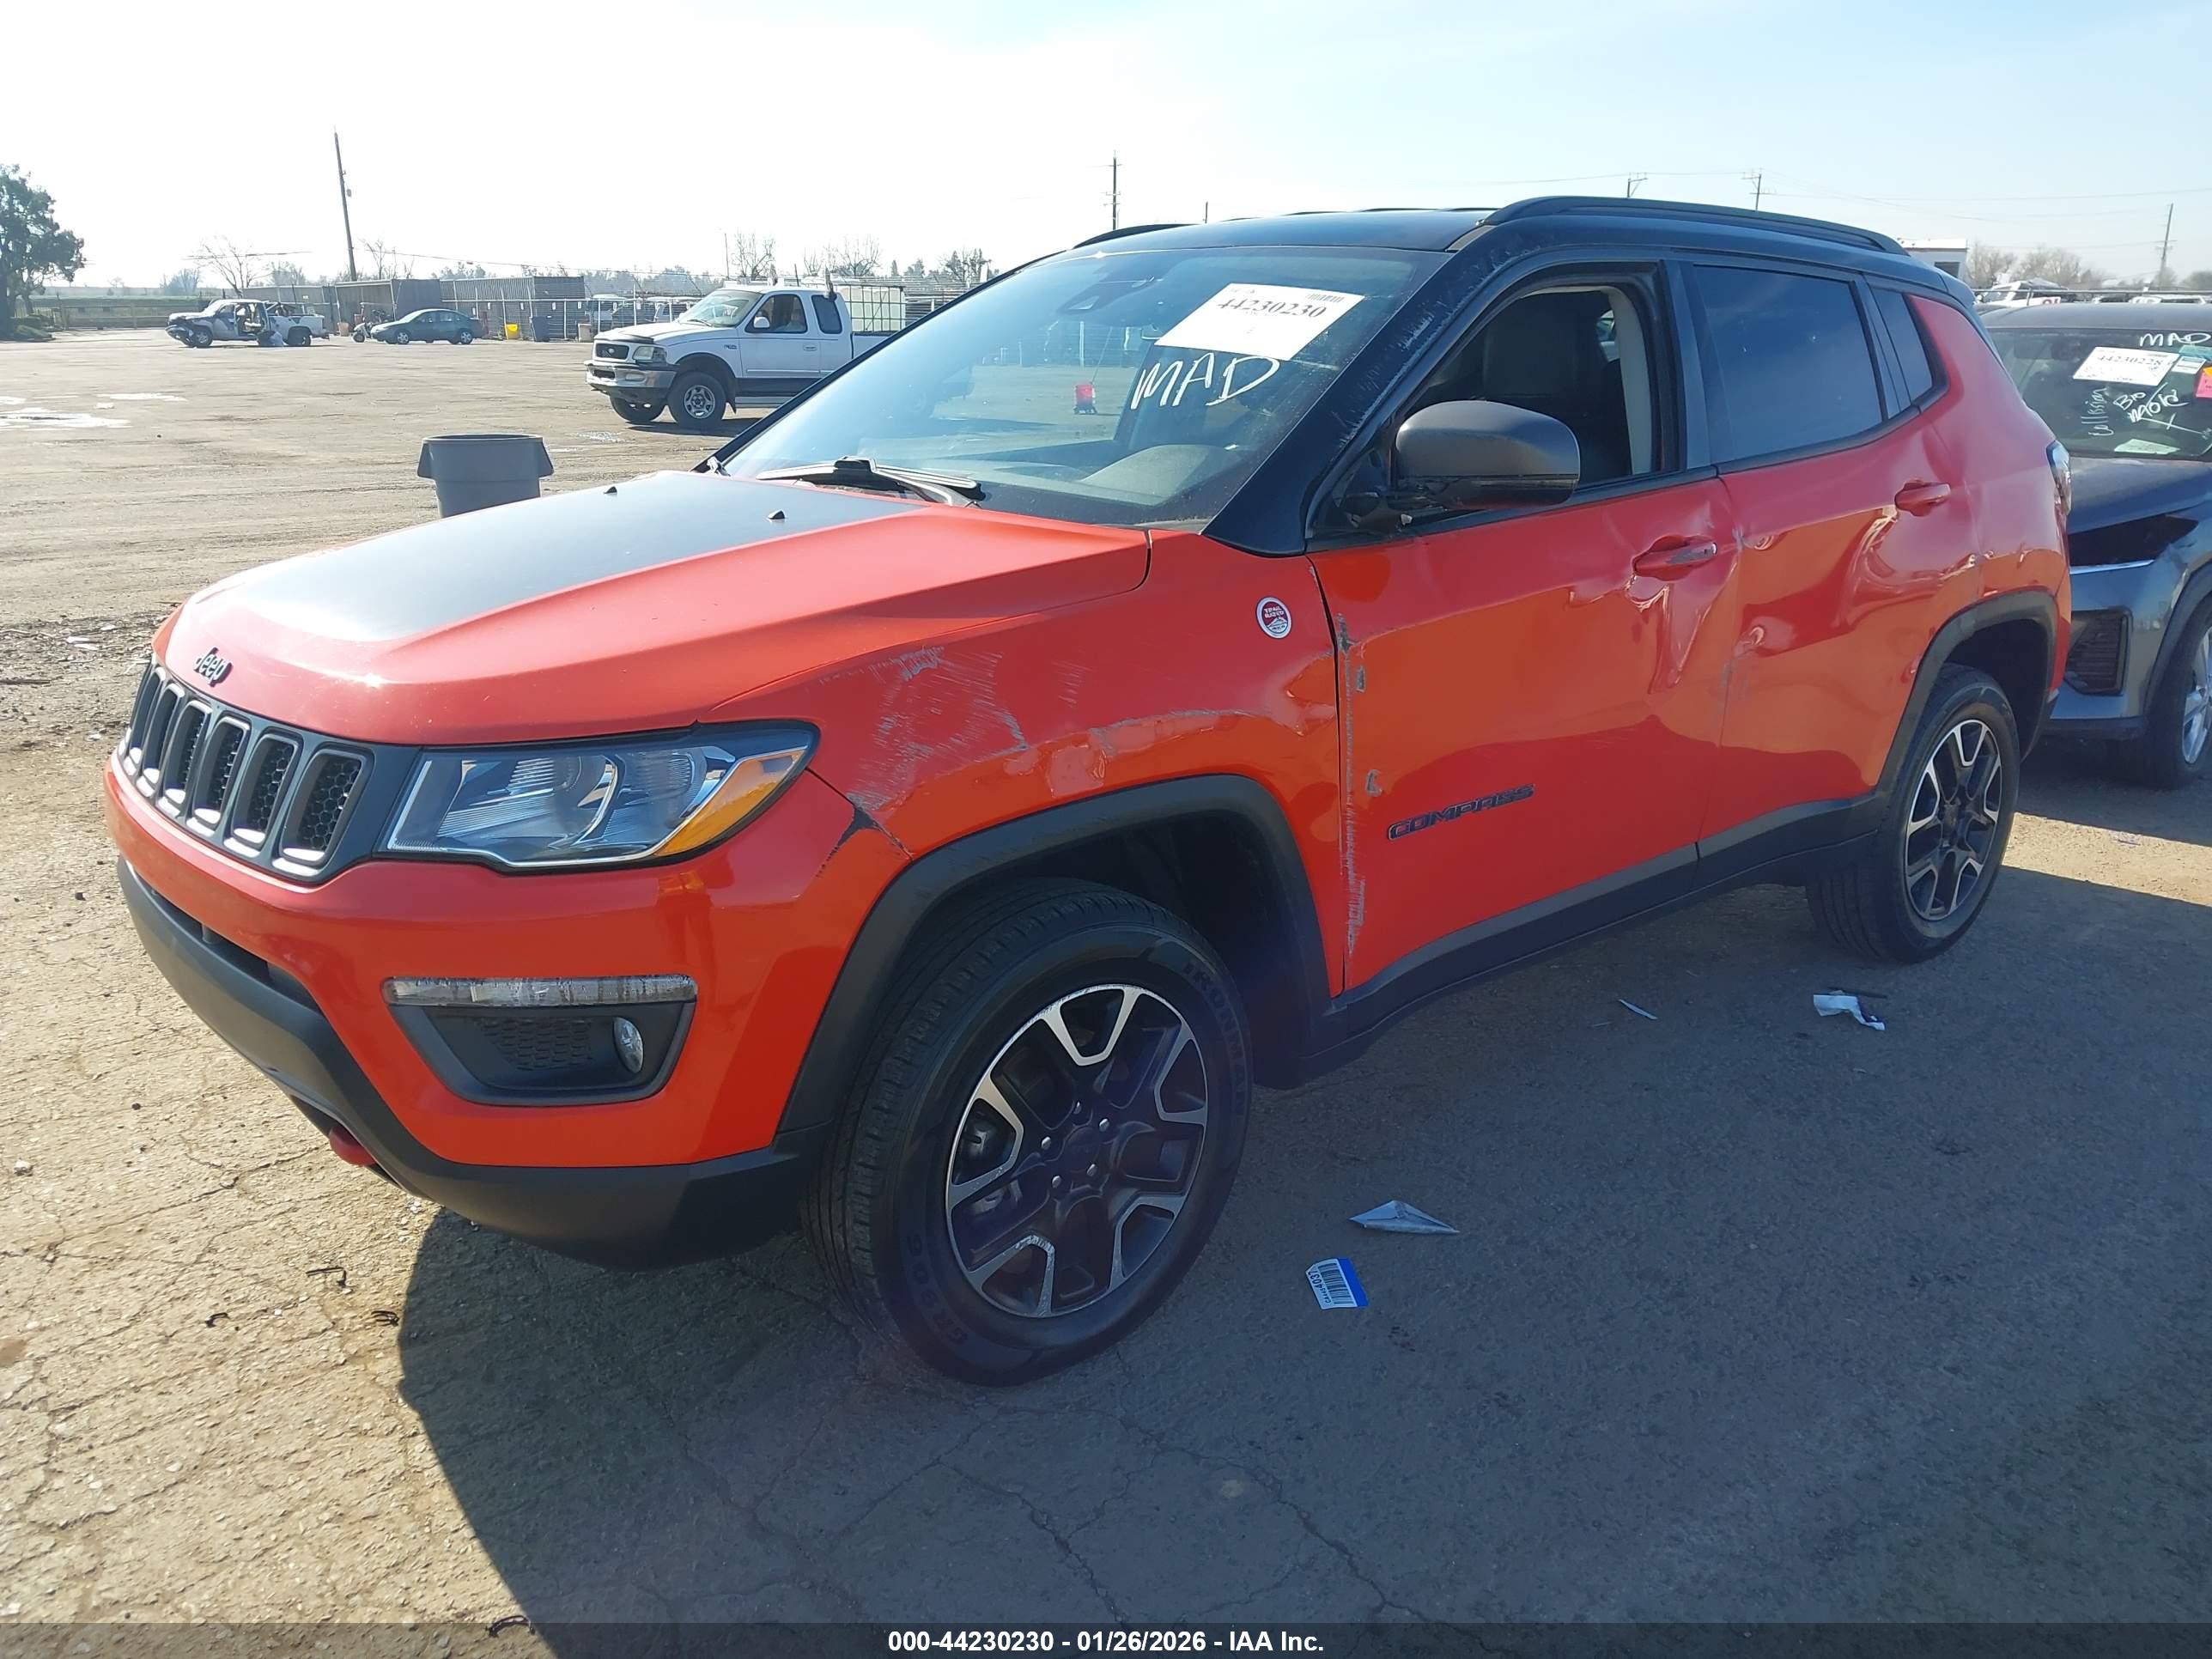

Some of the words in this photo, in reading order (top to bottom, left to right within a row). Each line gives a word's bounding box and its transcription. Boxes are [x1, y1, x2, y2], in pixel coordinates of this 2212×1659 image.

[1218, 298, 1327, 318] 44230230
[1130, 352, 1281, 410] MAD
[194, 647, 233, 688] Jeep
[1388, 783, 1535, 841] COMPASS
